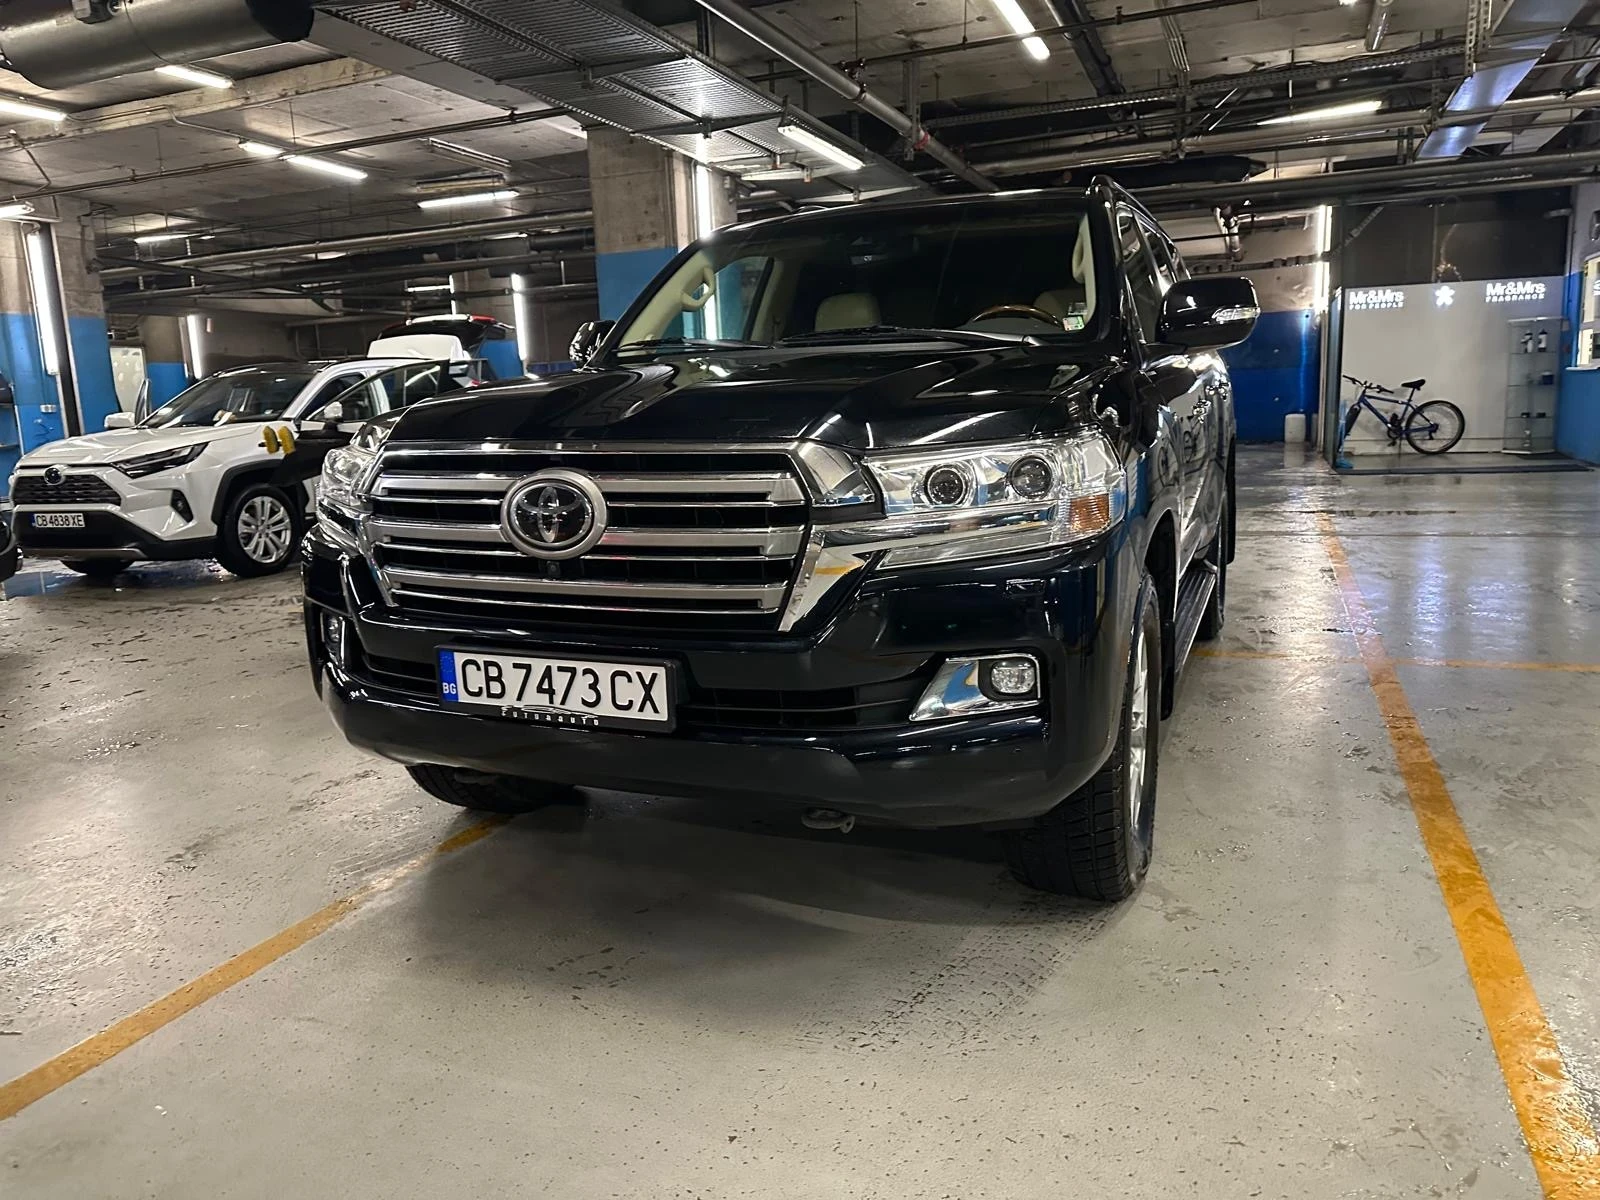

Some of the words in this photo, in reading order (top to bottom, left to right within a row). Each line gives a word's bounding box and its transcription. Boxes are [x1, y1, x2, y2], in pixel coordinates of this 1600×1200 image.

[1486, 281, 1546, 296] Mr&Mrs
[1349, 289, 1404, 304] Mr&Mrs
[36, 515, 47, 527] CB
[49, 515, 70, 527] 4838
[71, 515, 84, 527] XE
[442, 682, 457, 694] BG
[461, 658, 506, 699] CB
[512, 662, 602, 708] 7473
[609, 670, 660, 714] CX
